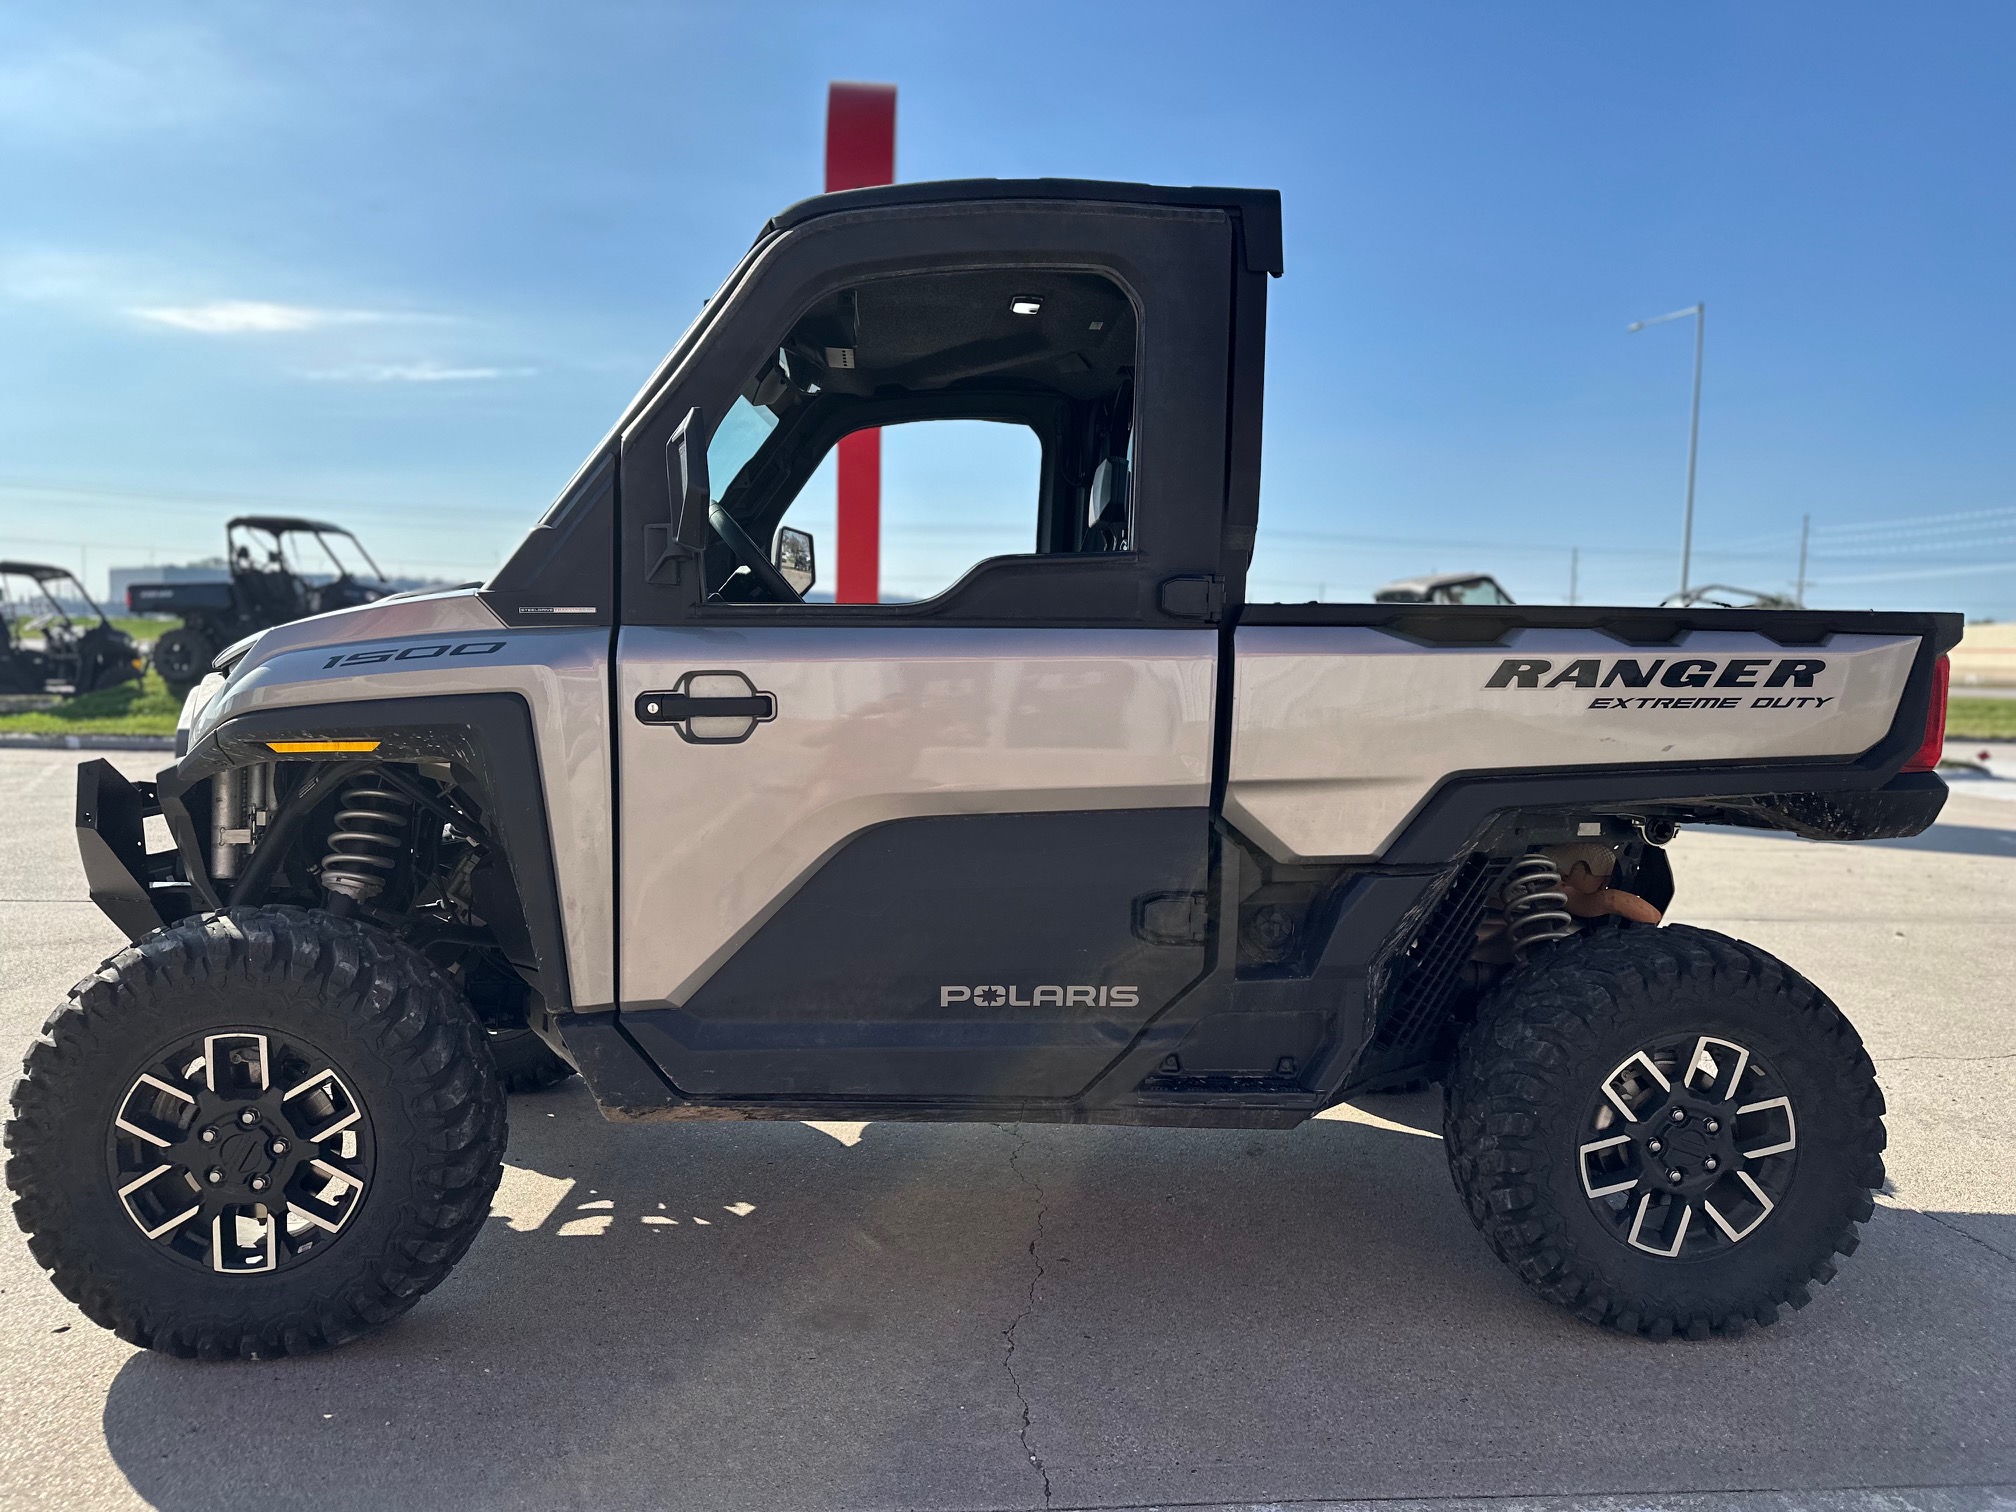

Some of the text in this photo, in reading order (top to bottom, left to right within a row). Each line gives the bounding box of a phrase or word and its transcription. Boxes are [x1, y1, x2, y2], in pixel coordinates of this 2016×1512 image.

[322, 641, 507, 670] 1500
[1483, 658, 1827, 689] RANGER
[1587, 697, 1836, 709] EXTREME DUTY
[940, 985, 1140, 1008] POLARIS
